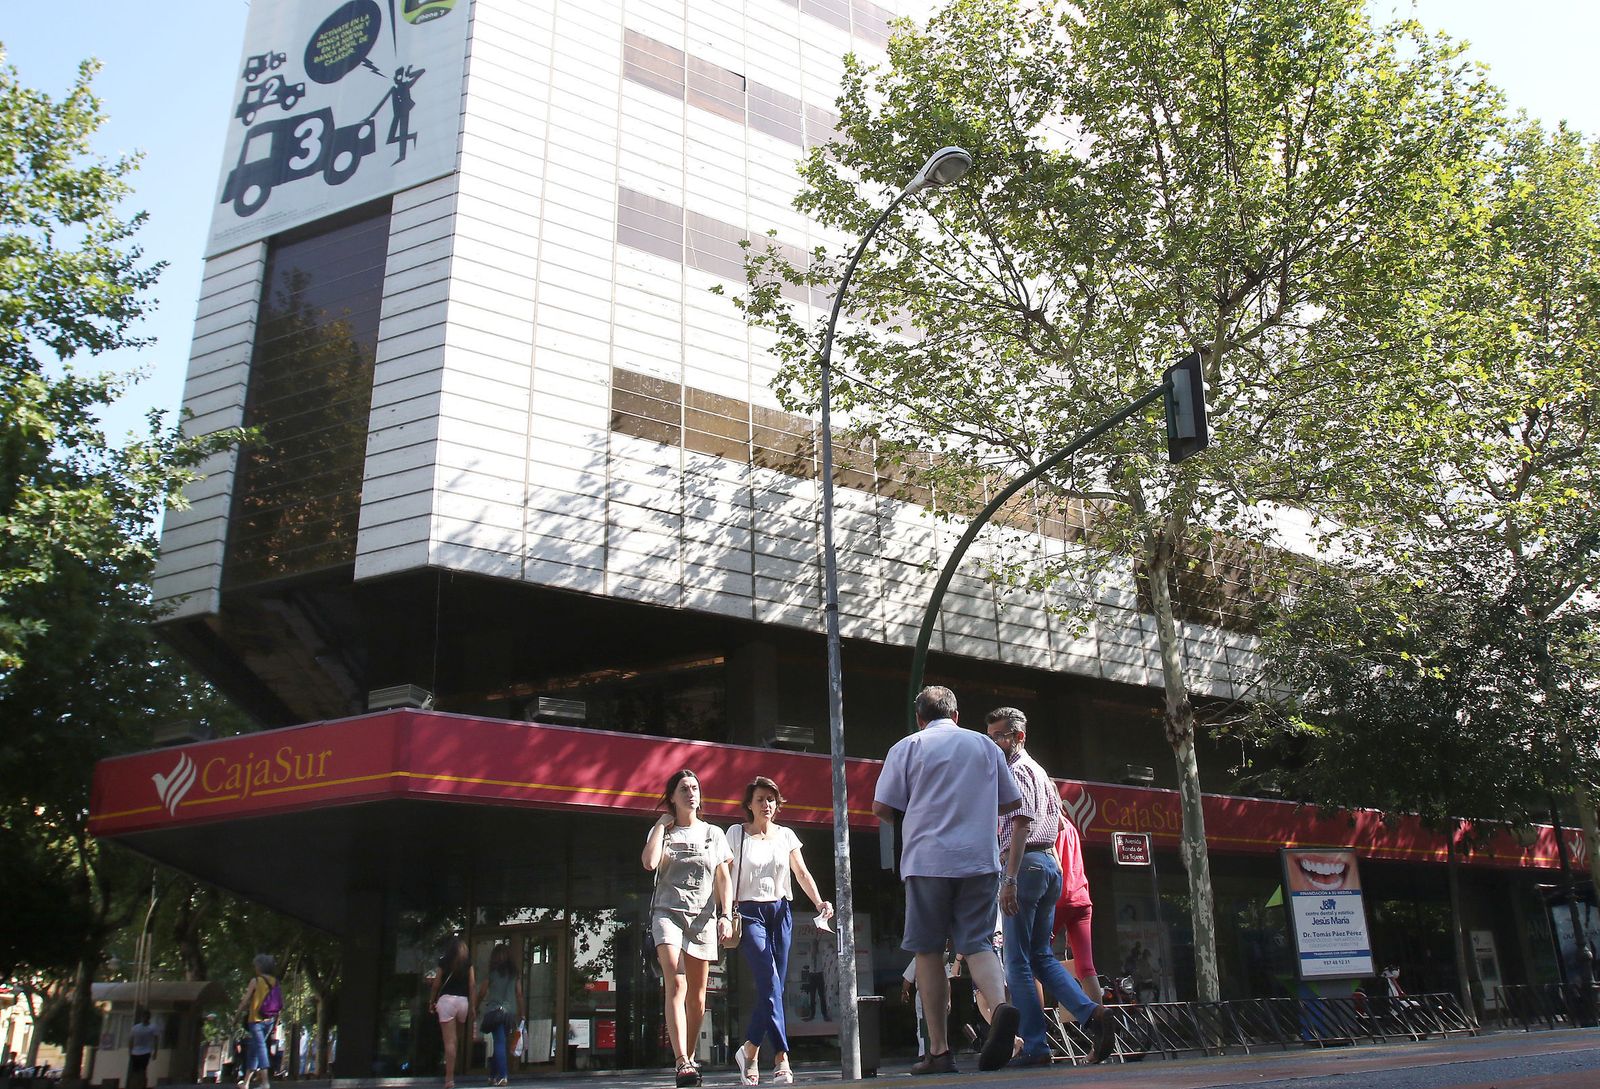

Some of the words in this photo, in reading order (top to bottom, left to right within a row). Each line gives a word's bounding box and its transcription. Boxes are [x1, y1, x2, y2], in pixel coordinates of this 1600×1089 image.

[262, 78, 280, 104] 2
[288, 117, 325, 171] 3
[202, 746, 333, 800] CajaSur
[1101, 798, 1182, 832] CajaSu
[1311, 916, 1330, 926] Jesús
[1330, 915, 1350, 925] María
